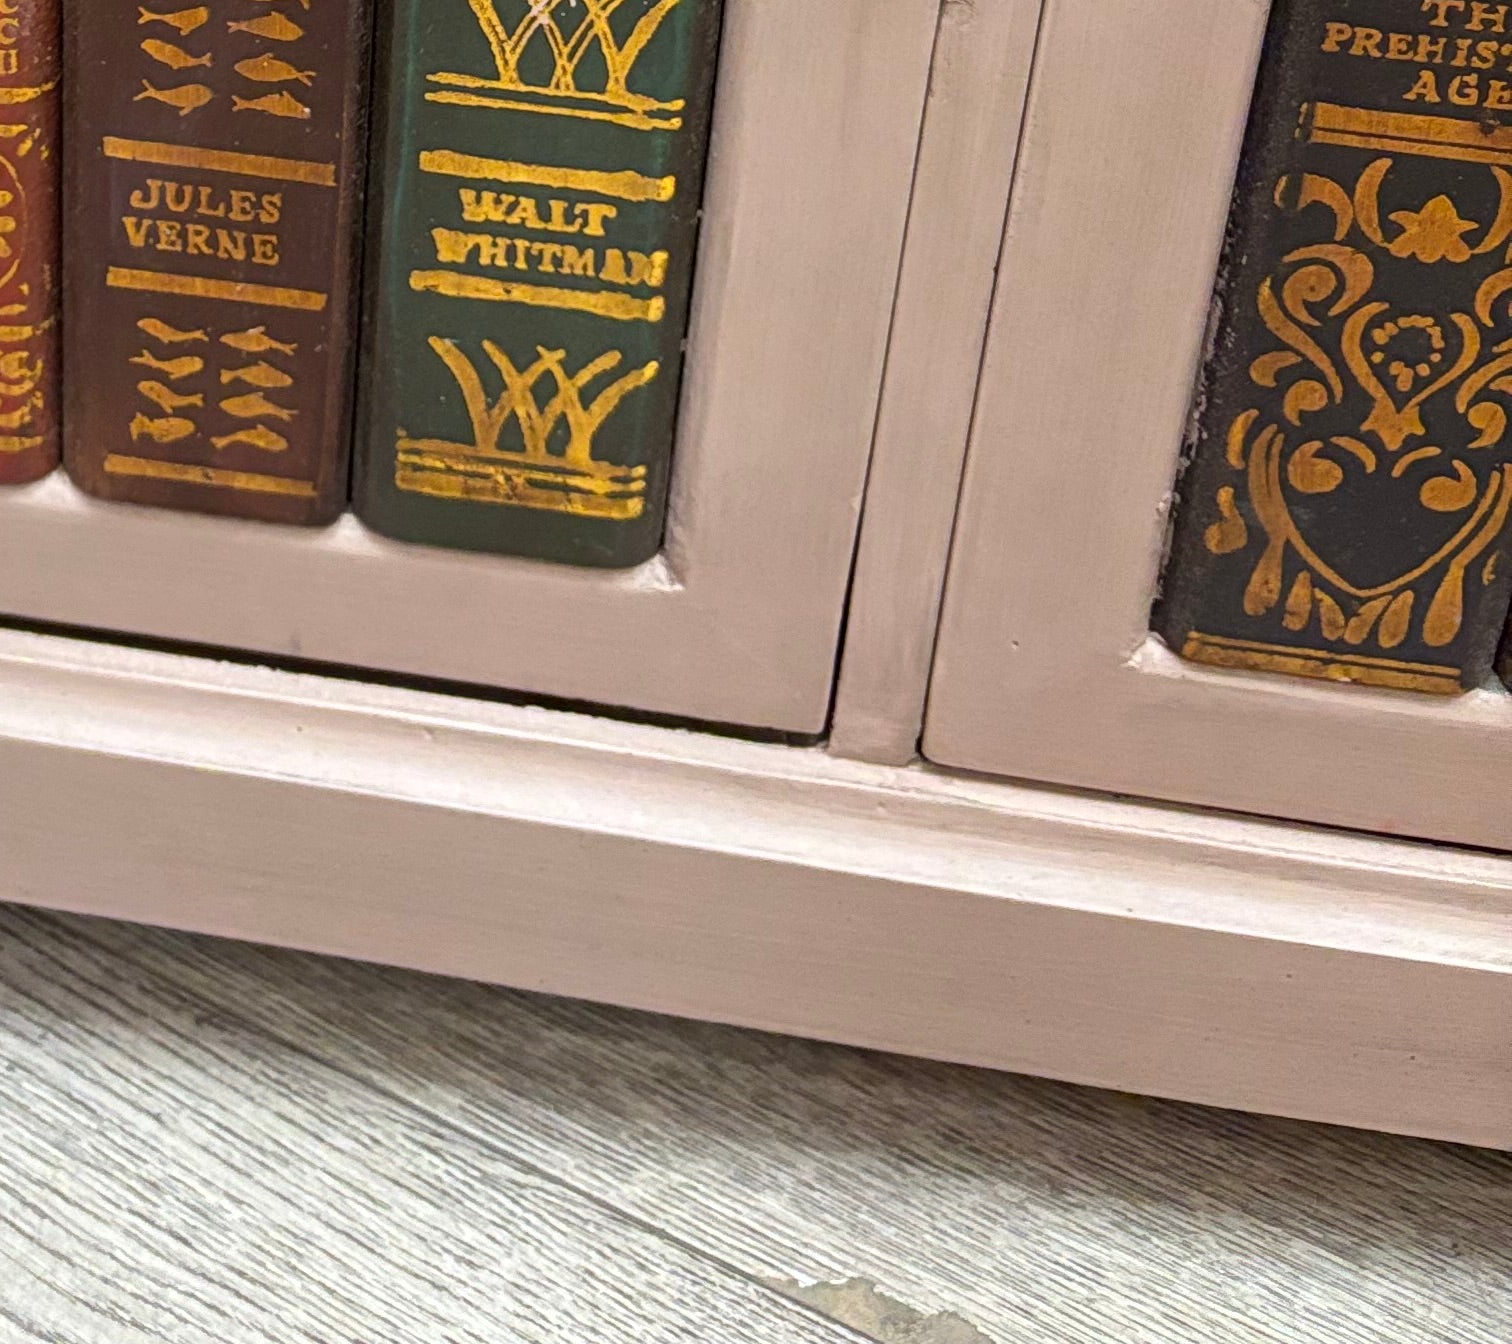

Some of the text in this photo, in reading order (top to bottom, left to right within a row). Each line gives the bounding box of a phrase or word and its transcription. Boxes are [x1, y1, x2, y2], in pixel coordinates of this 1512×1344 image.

[129, 178, 282, 224] JULES
[459, 188, 617, 236] WALT
[122, 216, 280, 266] VERNE
[431, 227, 669, 288] WHITMAN
